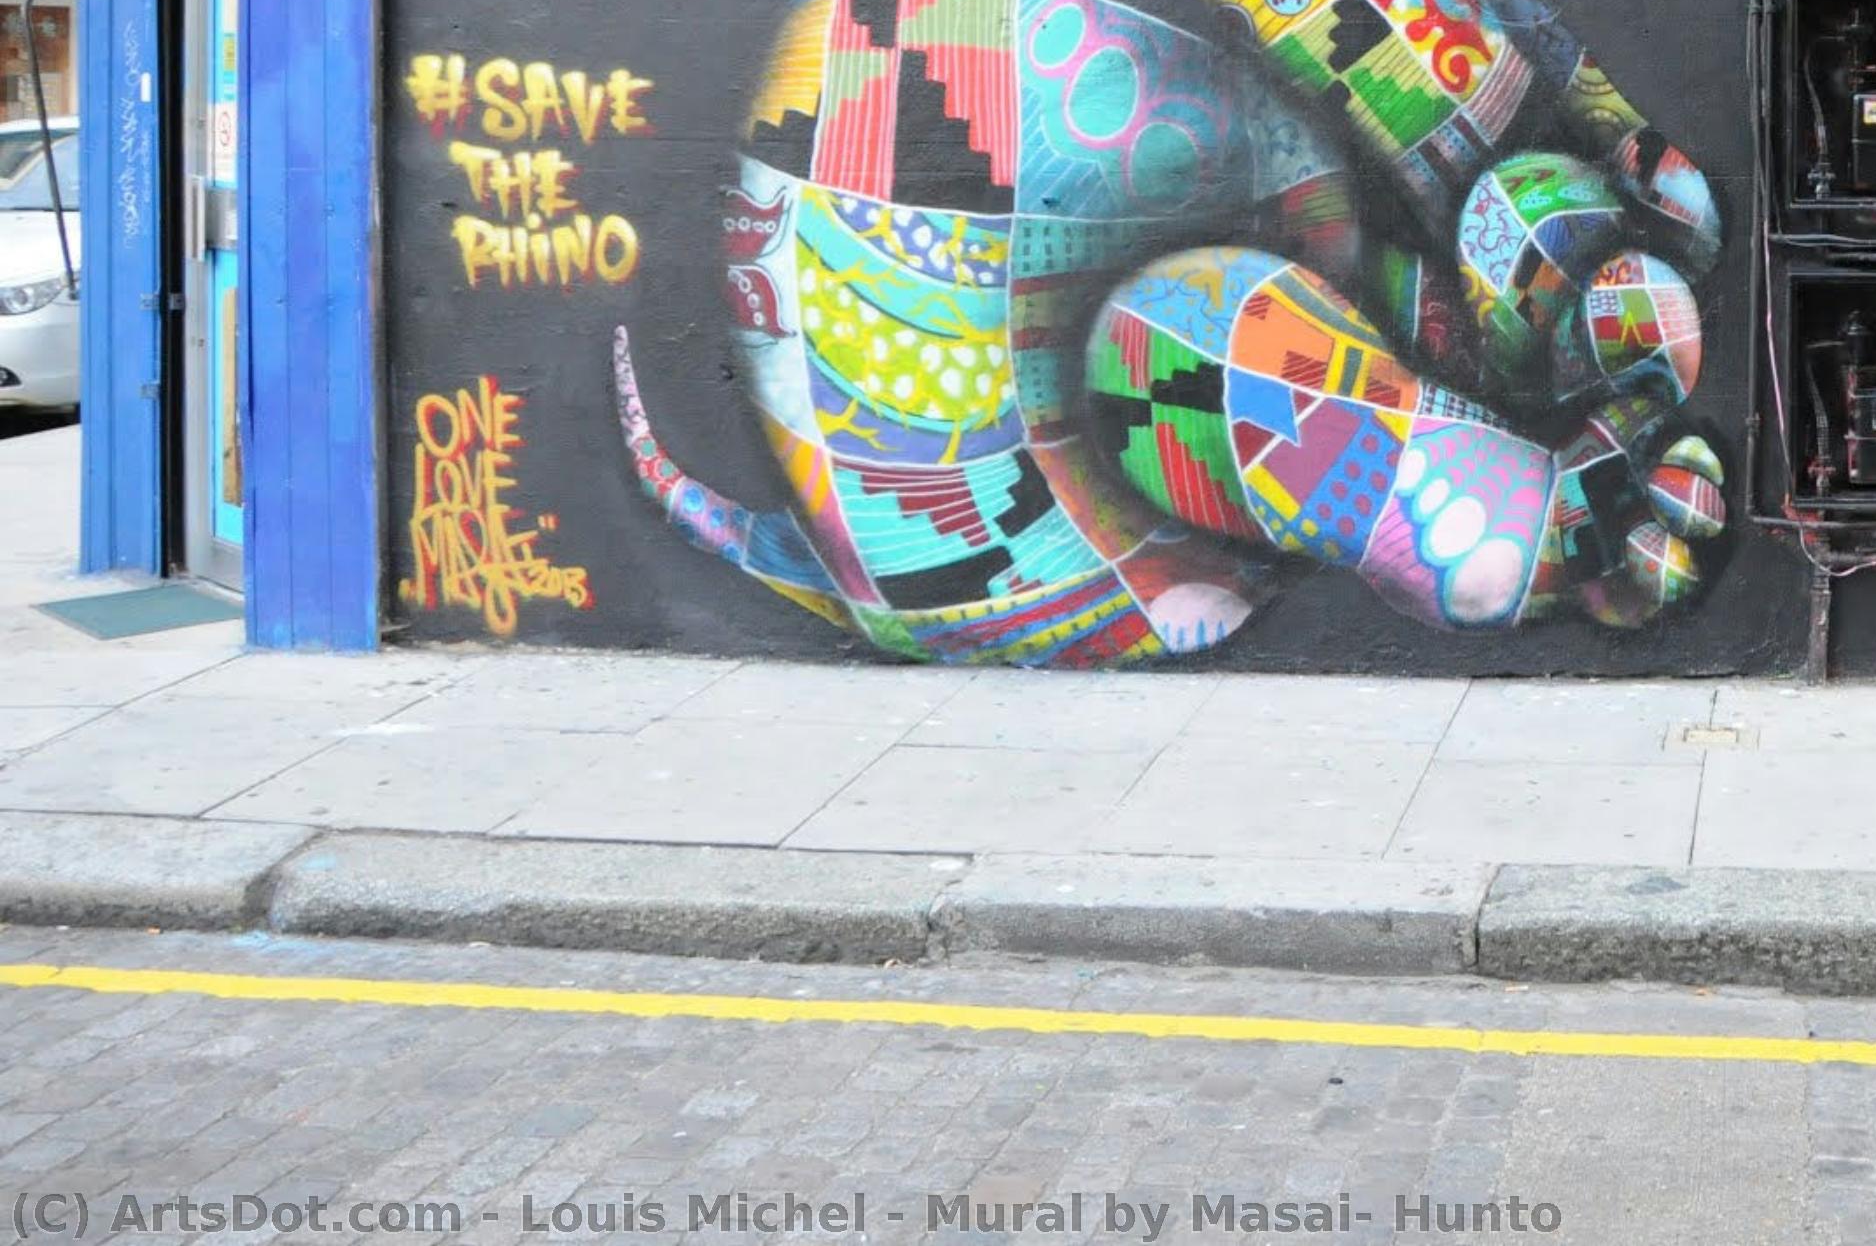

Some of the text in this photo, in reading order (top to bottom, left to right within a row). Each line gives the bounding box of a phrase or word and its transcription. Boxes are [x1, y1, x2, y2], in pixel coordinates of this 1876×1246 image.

[449, 141, 582, 218] THE
[416, 375, 526, 458] ONE
[414, 442, 524, 516] LOVE
